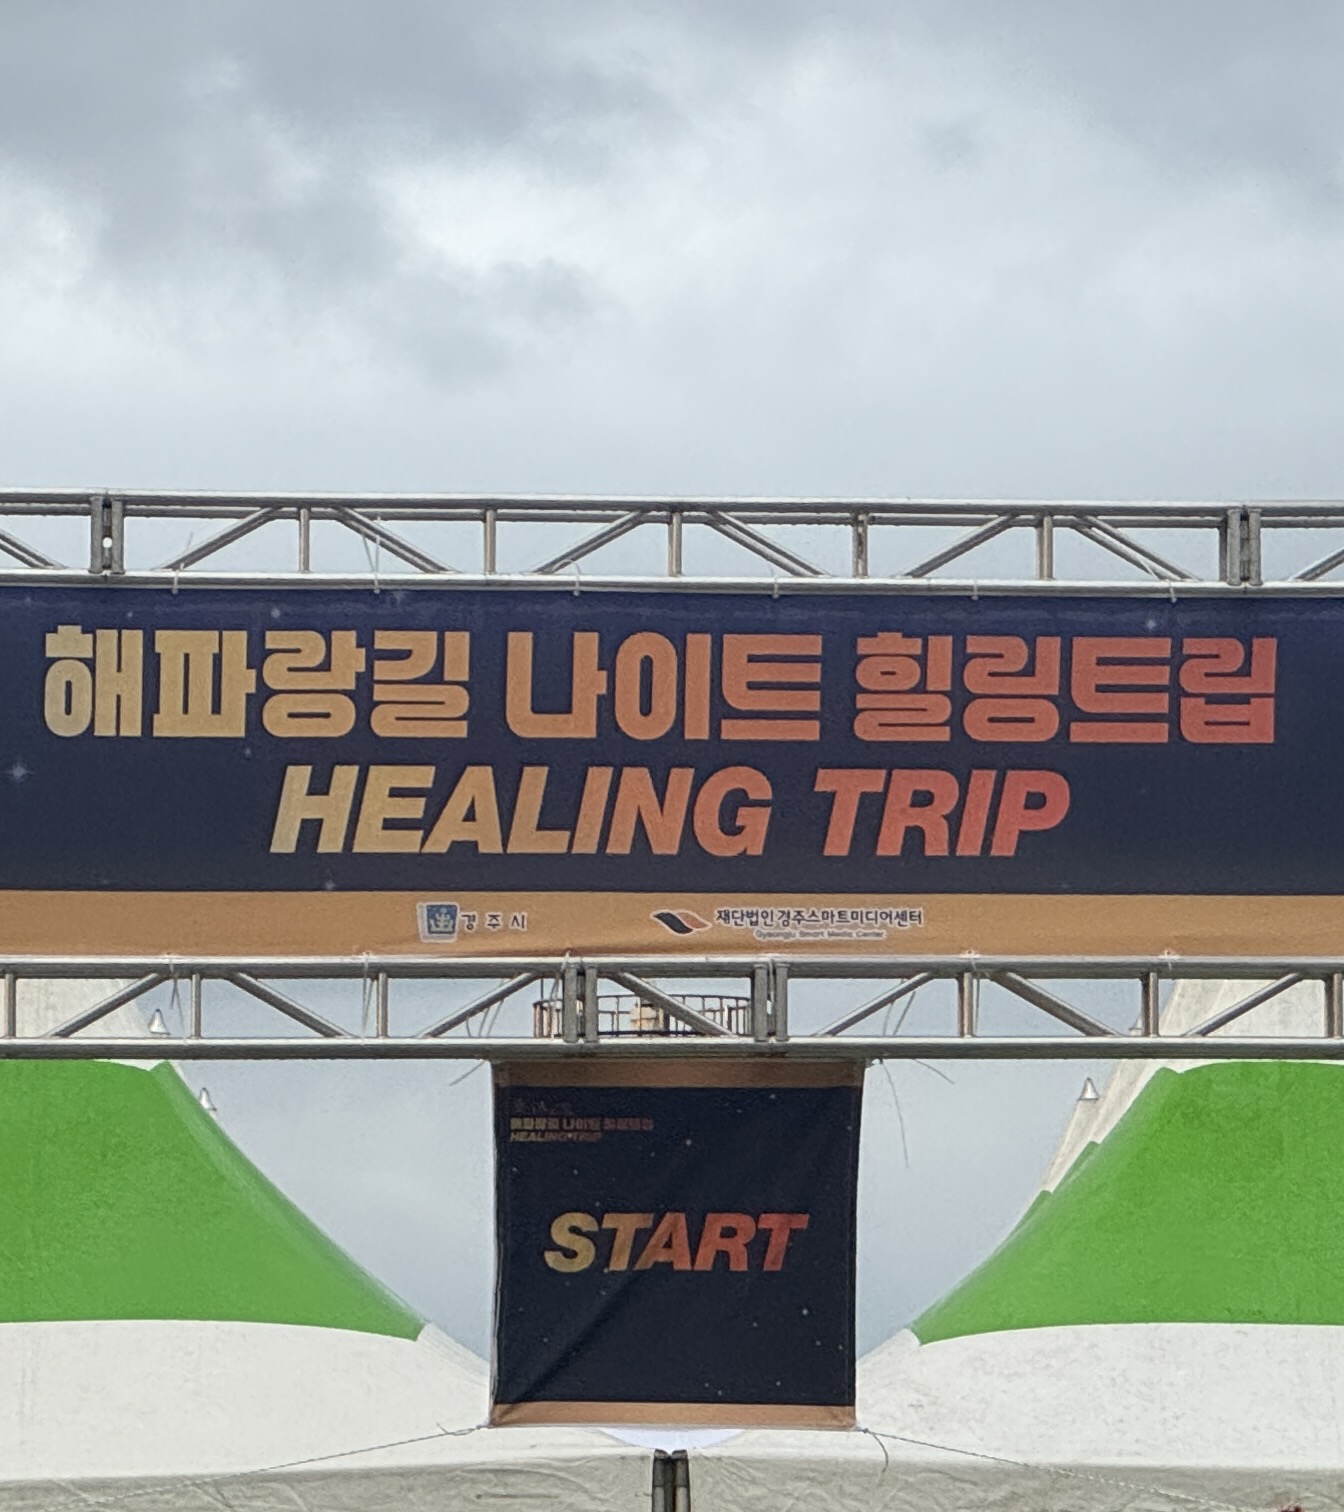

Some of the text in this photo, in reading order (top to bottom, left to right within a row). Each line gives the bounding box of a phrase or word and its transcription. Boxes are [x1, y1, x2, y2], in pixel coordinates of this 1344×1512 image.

[45, 625, 1277, 744] 해파랑길 나이트 힐링트립
[270, 765, 1071, 858] HEALING TRIP
[544, 1211, 810, 1274] START
